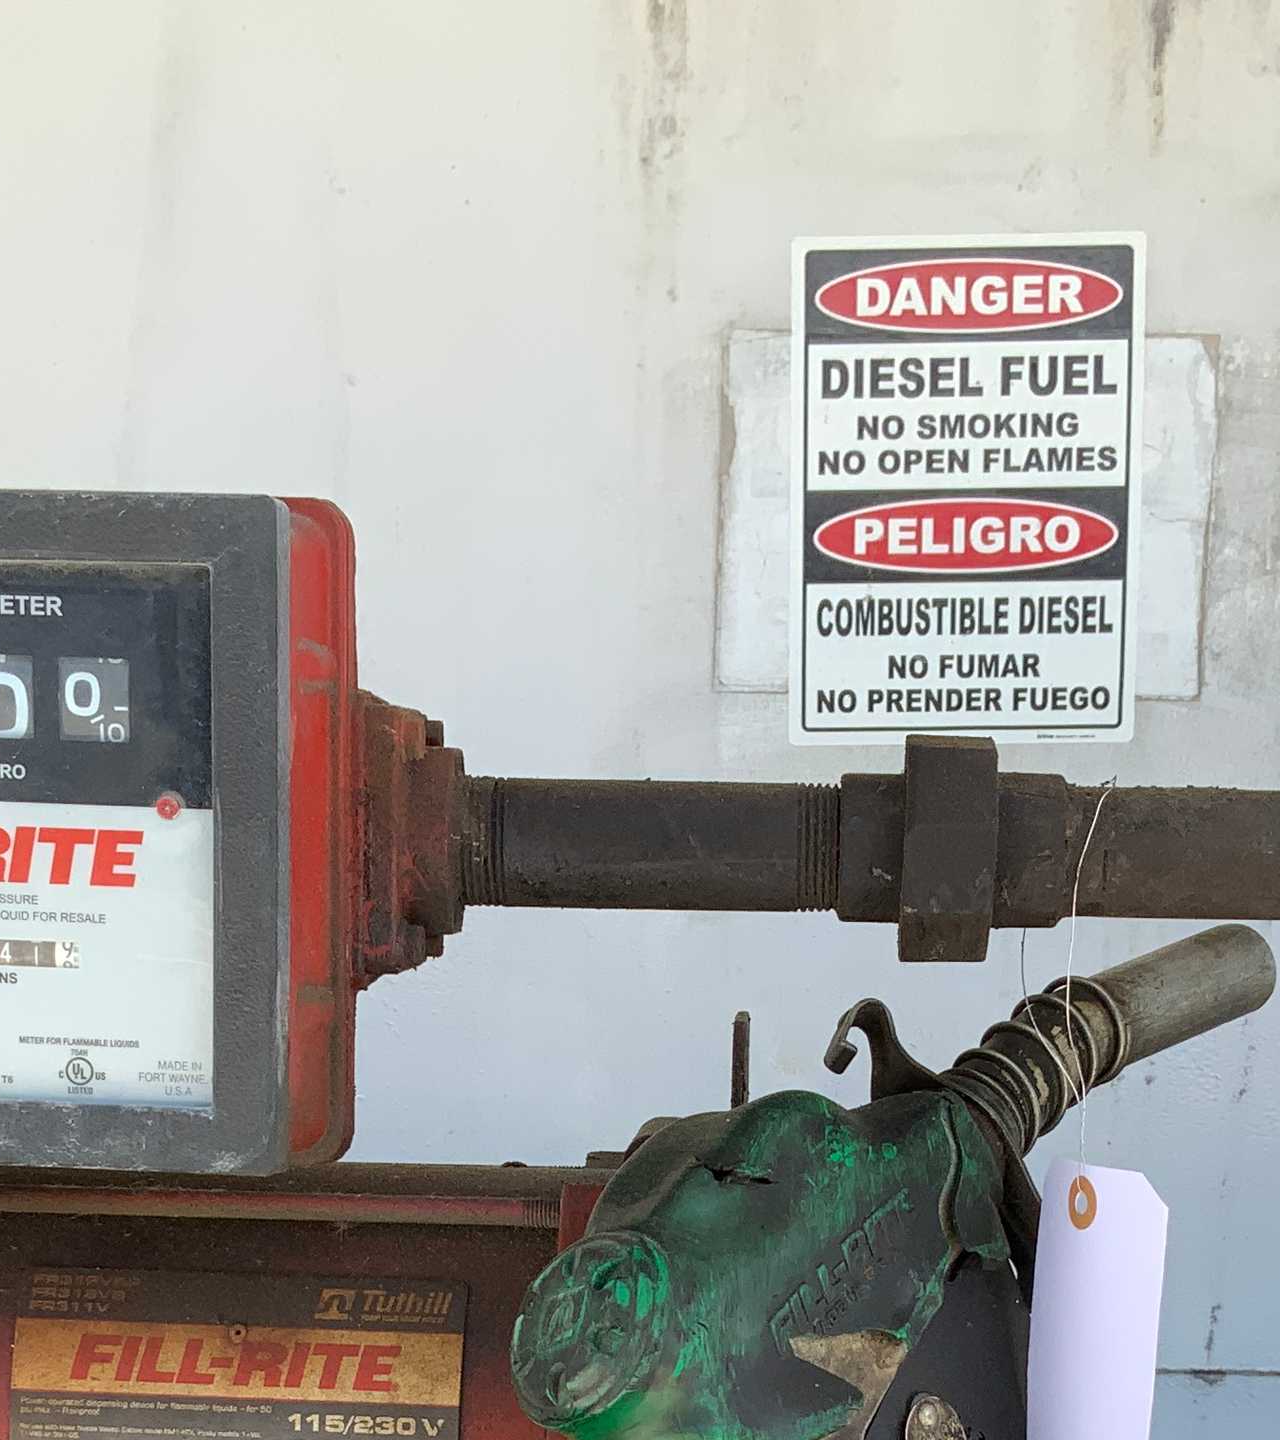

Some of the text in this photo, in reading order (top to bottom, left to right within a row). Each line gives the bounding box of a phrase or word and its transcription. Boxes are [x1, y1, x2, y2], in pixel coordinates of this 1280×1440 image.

[855, 274, 1084, 317] DANGER
[821, 355, 1118, 399] DIESEL FUEL
[857, 412, 1079, 440] NO SMOKING
[818, 446, 1118, 476] NO OPEN FLAMES
[853, 515, 1081, 555] PELIGRO
[816, 596, 1113, 637] COMBUSTIBLE DIESEL
[887, 653, 1041, 679] NO FUMAR
[816, 686, 1111, 714] NO PRENDER FUEGO
[33, 911, 57, 922] FOR
[60, 912, 107, 924] RESALE
[19, 1035, 140, 1049] METER FOR FLAMMABLE LIQUIDS
[95, 1071, 106, 1081] US
[138, 1072, 166, 1083] FORT
[158, 1061, 202, 1072] MADE IN
[363, 1290, 452, 1314] Tuthill
[70, 1333, 403, 1392] FILL-RITE
[288, 1413, 444, 1436] 115/230 V
